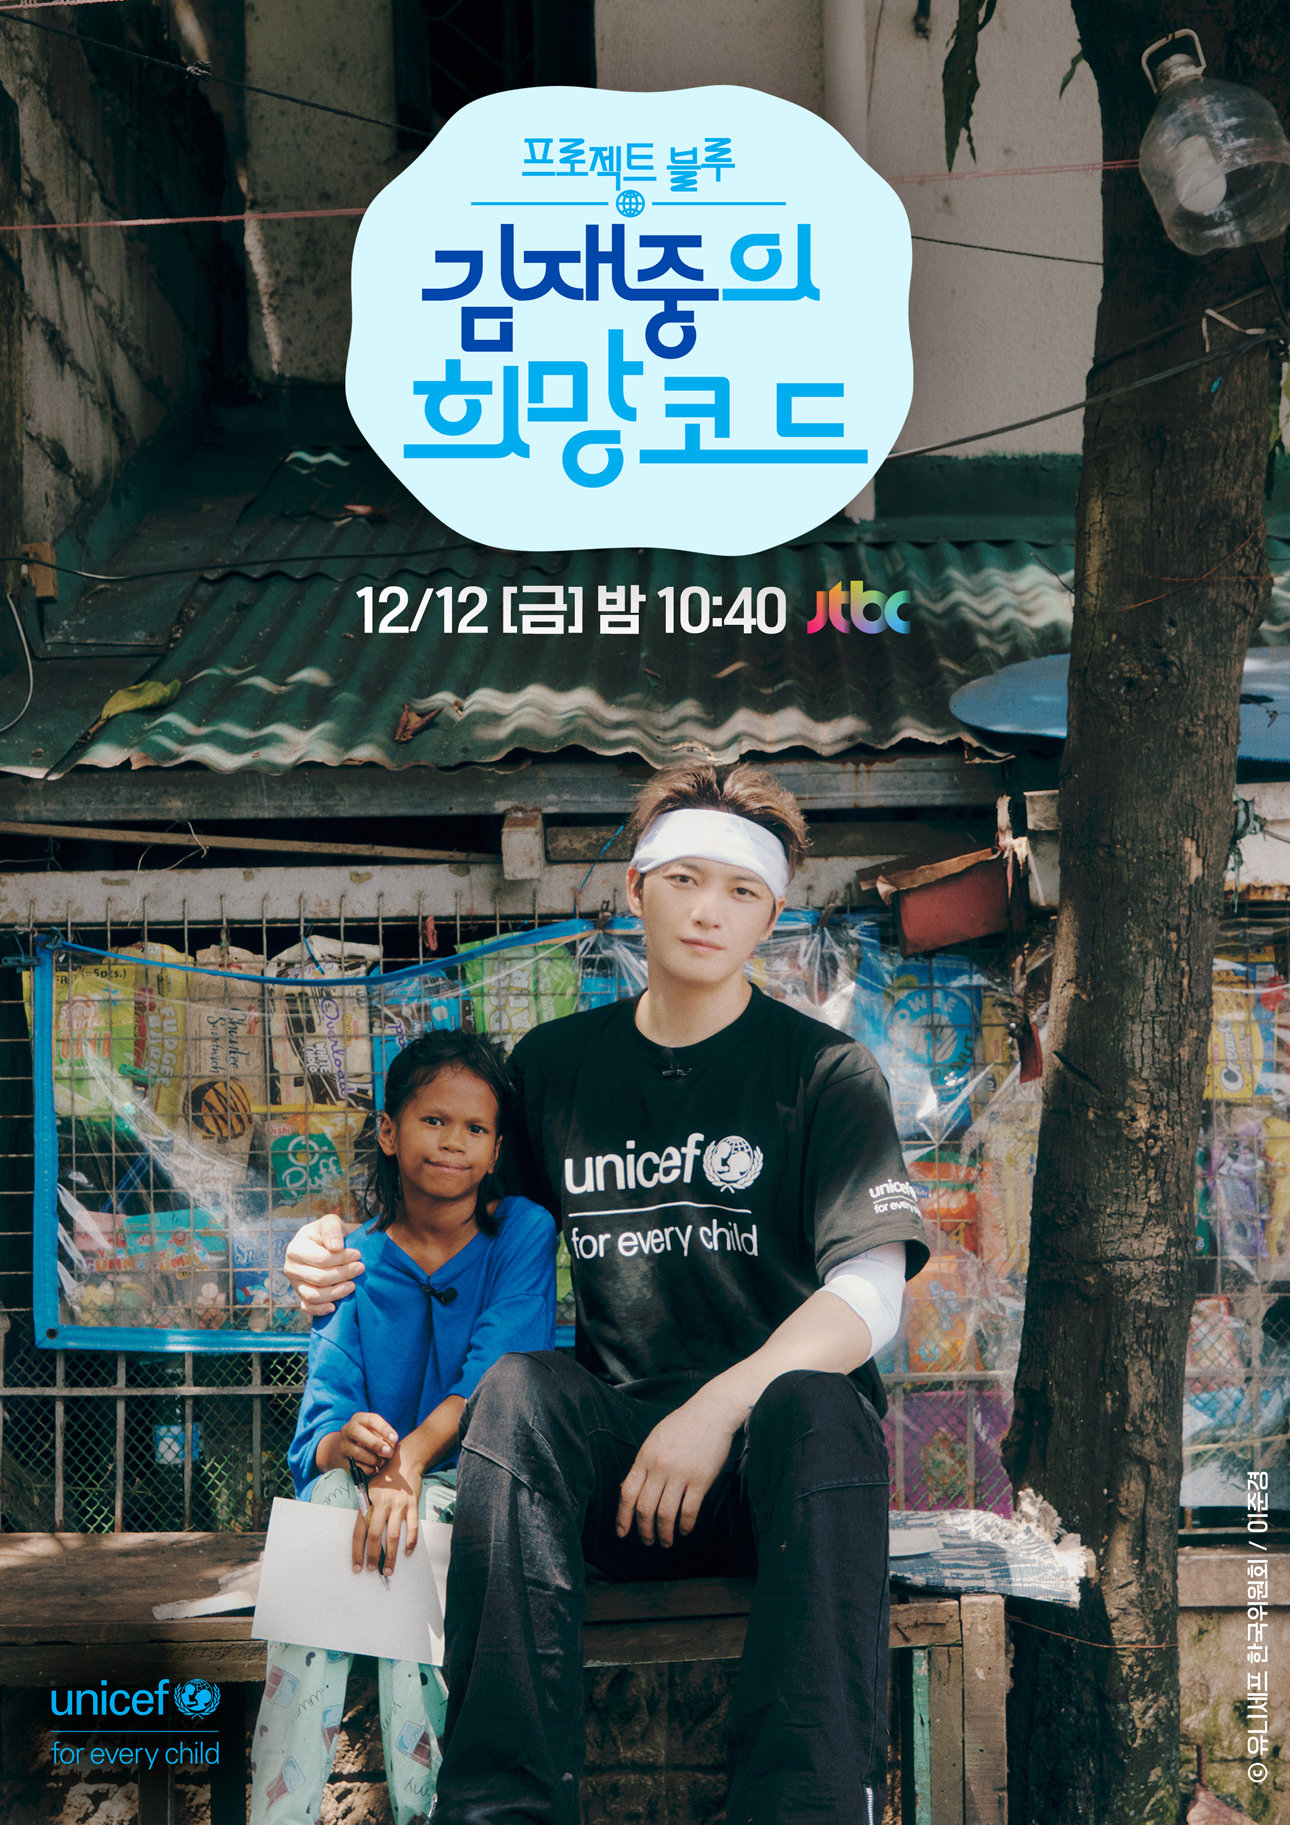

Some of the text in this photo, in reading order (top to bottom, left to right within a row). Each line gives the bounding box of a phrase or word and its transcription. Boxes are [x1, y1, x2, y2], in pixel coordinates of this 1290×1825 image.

[564, 1132, 705, 1194] unicef
[874, 1203, 888, 1214] for
[571, 1218, 758, 1260] for every child
